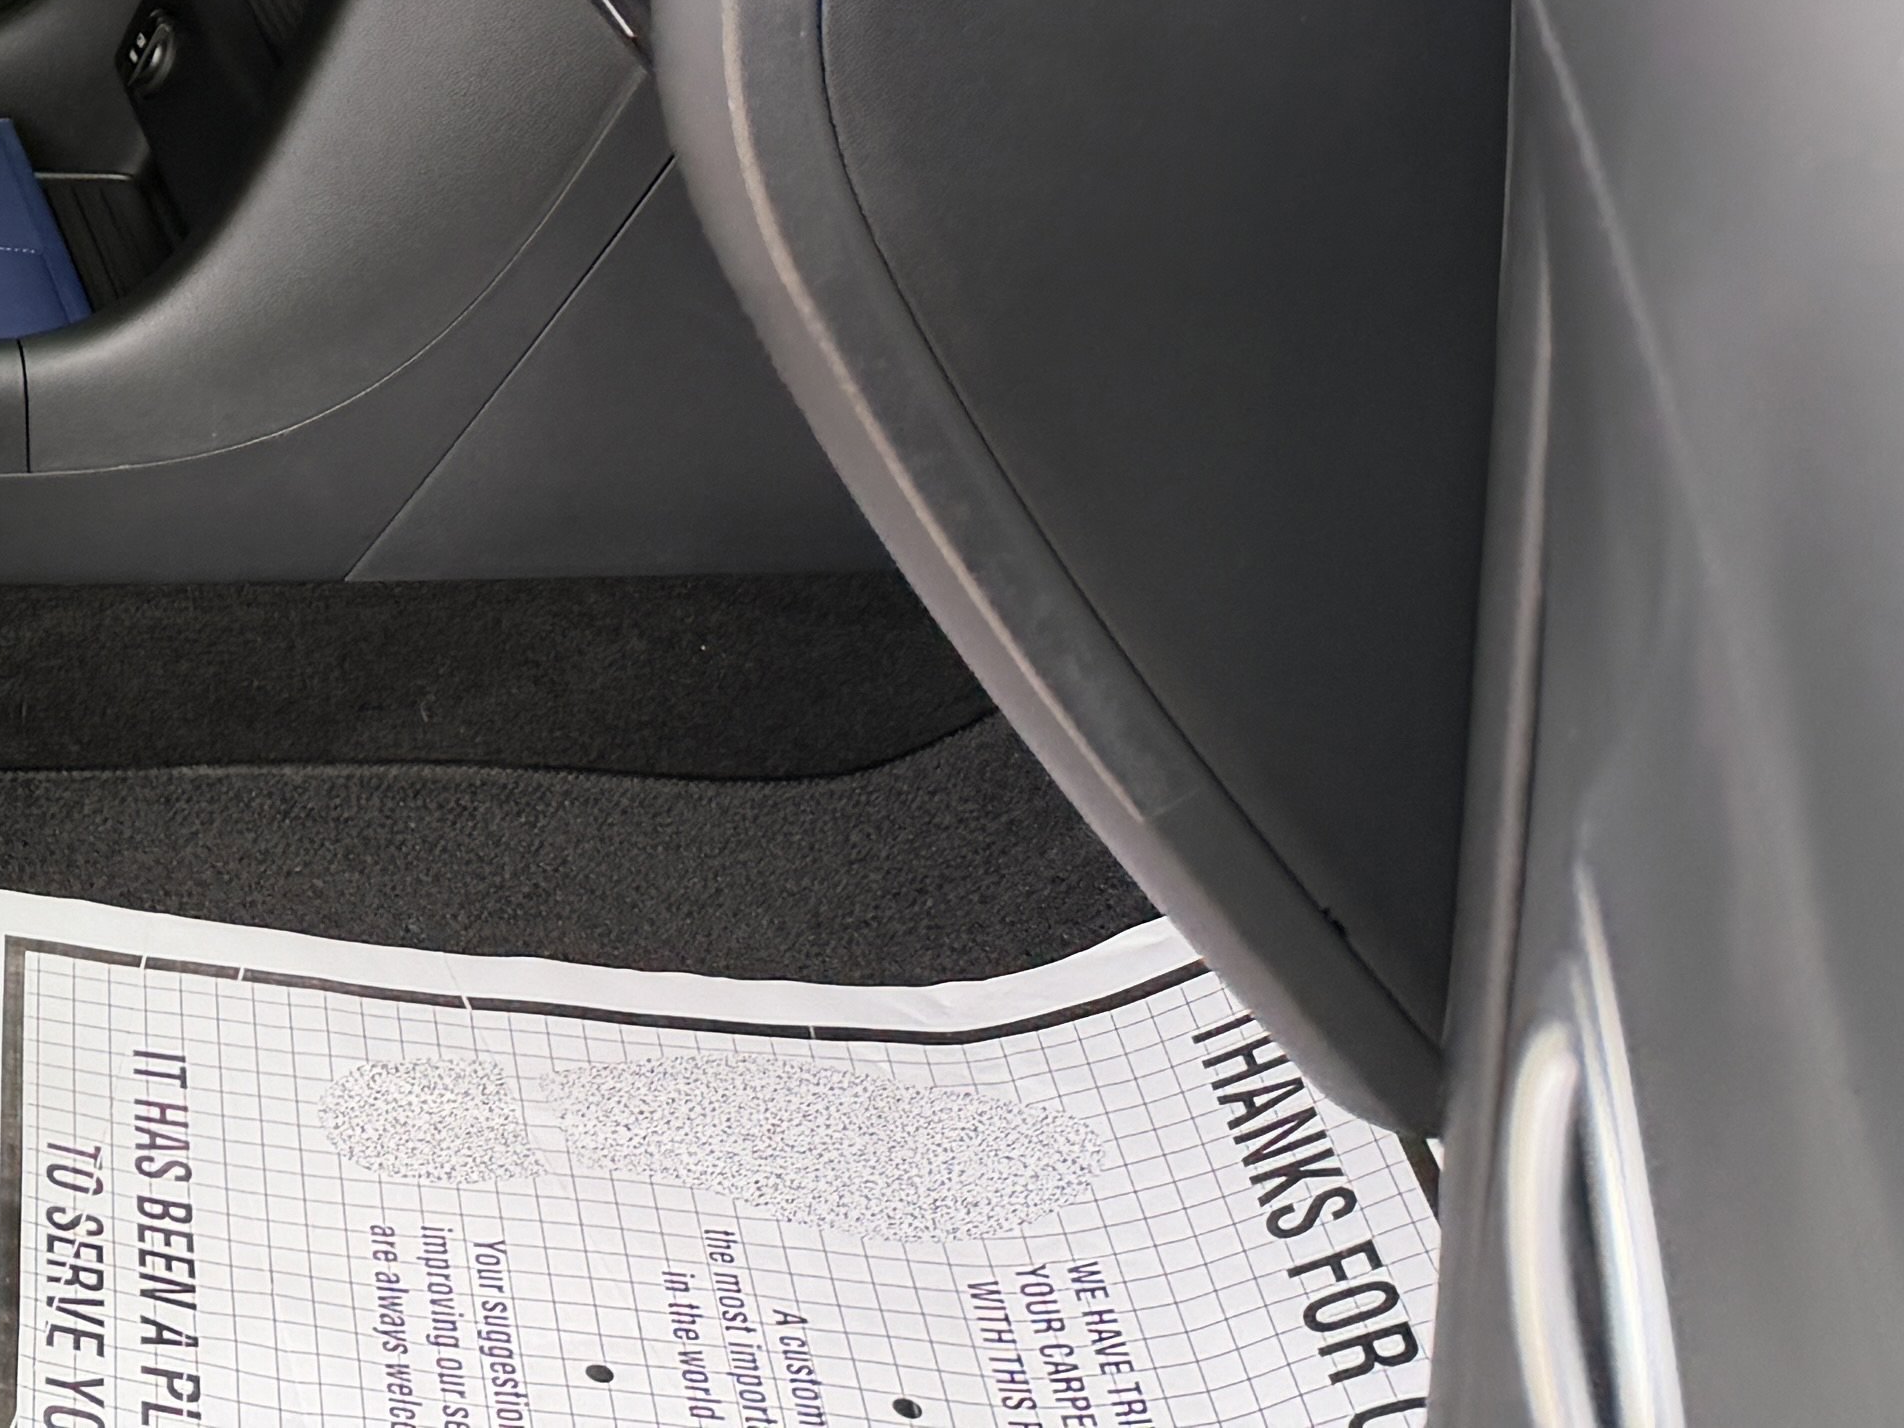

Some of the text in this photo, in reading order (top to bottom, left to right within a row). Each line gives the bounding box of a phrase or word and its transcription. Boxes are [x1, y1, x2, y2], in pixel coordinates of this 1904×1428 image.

[46, 1142, 104, 1197] TO
[133, 1049, 202, 1427] IT HAS BEEN A PL
[370, 1224, 399, 1264] are
[473, 1240, 508, 1294] Your
[44, 1205, 106, 1359] SERVE
[372, 1271, 410, 1356] always
[415, 1224, 465, 1349] improving
[967, 1280, 1018, 1344] WITH
[1067, 1261, 1110, 1302] WE
[1287, 1239, 1420, 1386] FOR
[661, 1271, 726, 1422] in the world
[703, 1229, 779, 1428] the most import
[773, 1308, 827, 1427] A custom
[1015, 1263, 1099, 1428] YOUR CARPE
[1081, 1309, 1136, 1375] HAVE
[435, 1357, 468, 1400] our
[988, 1353, 1038, 1411] THIS
